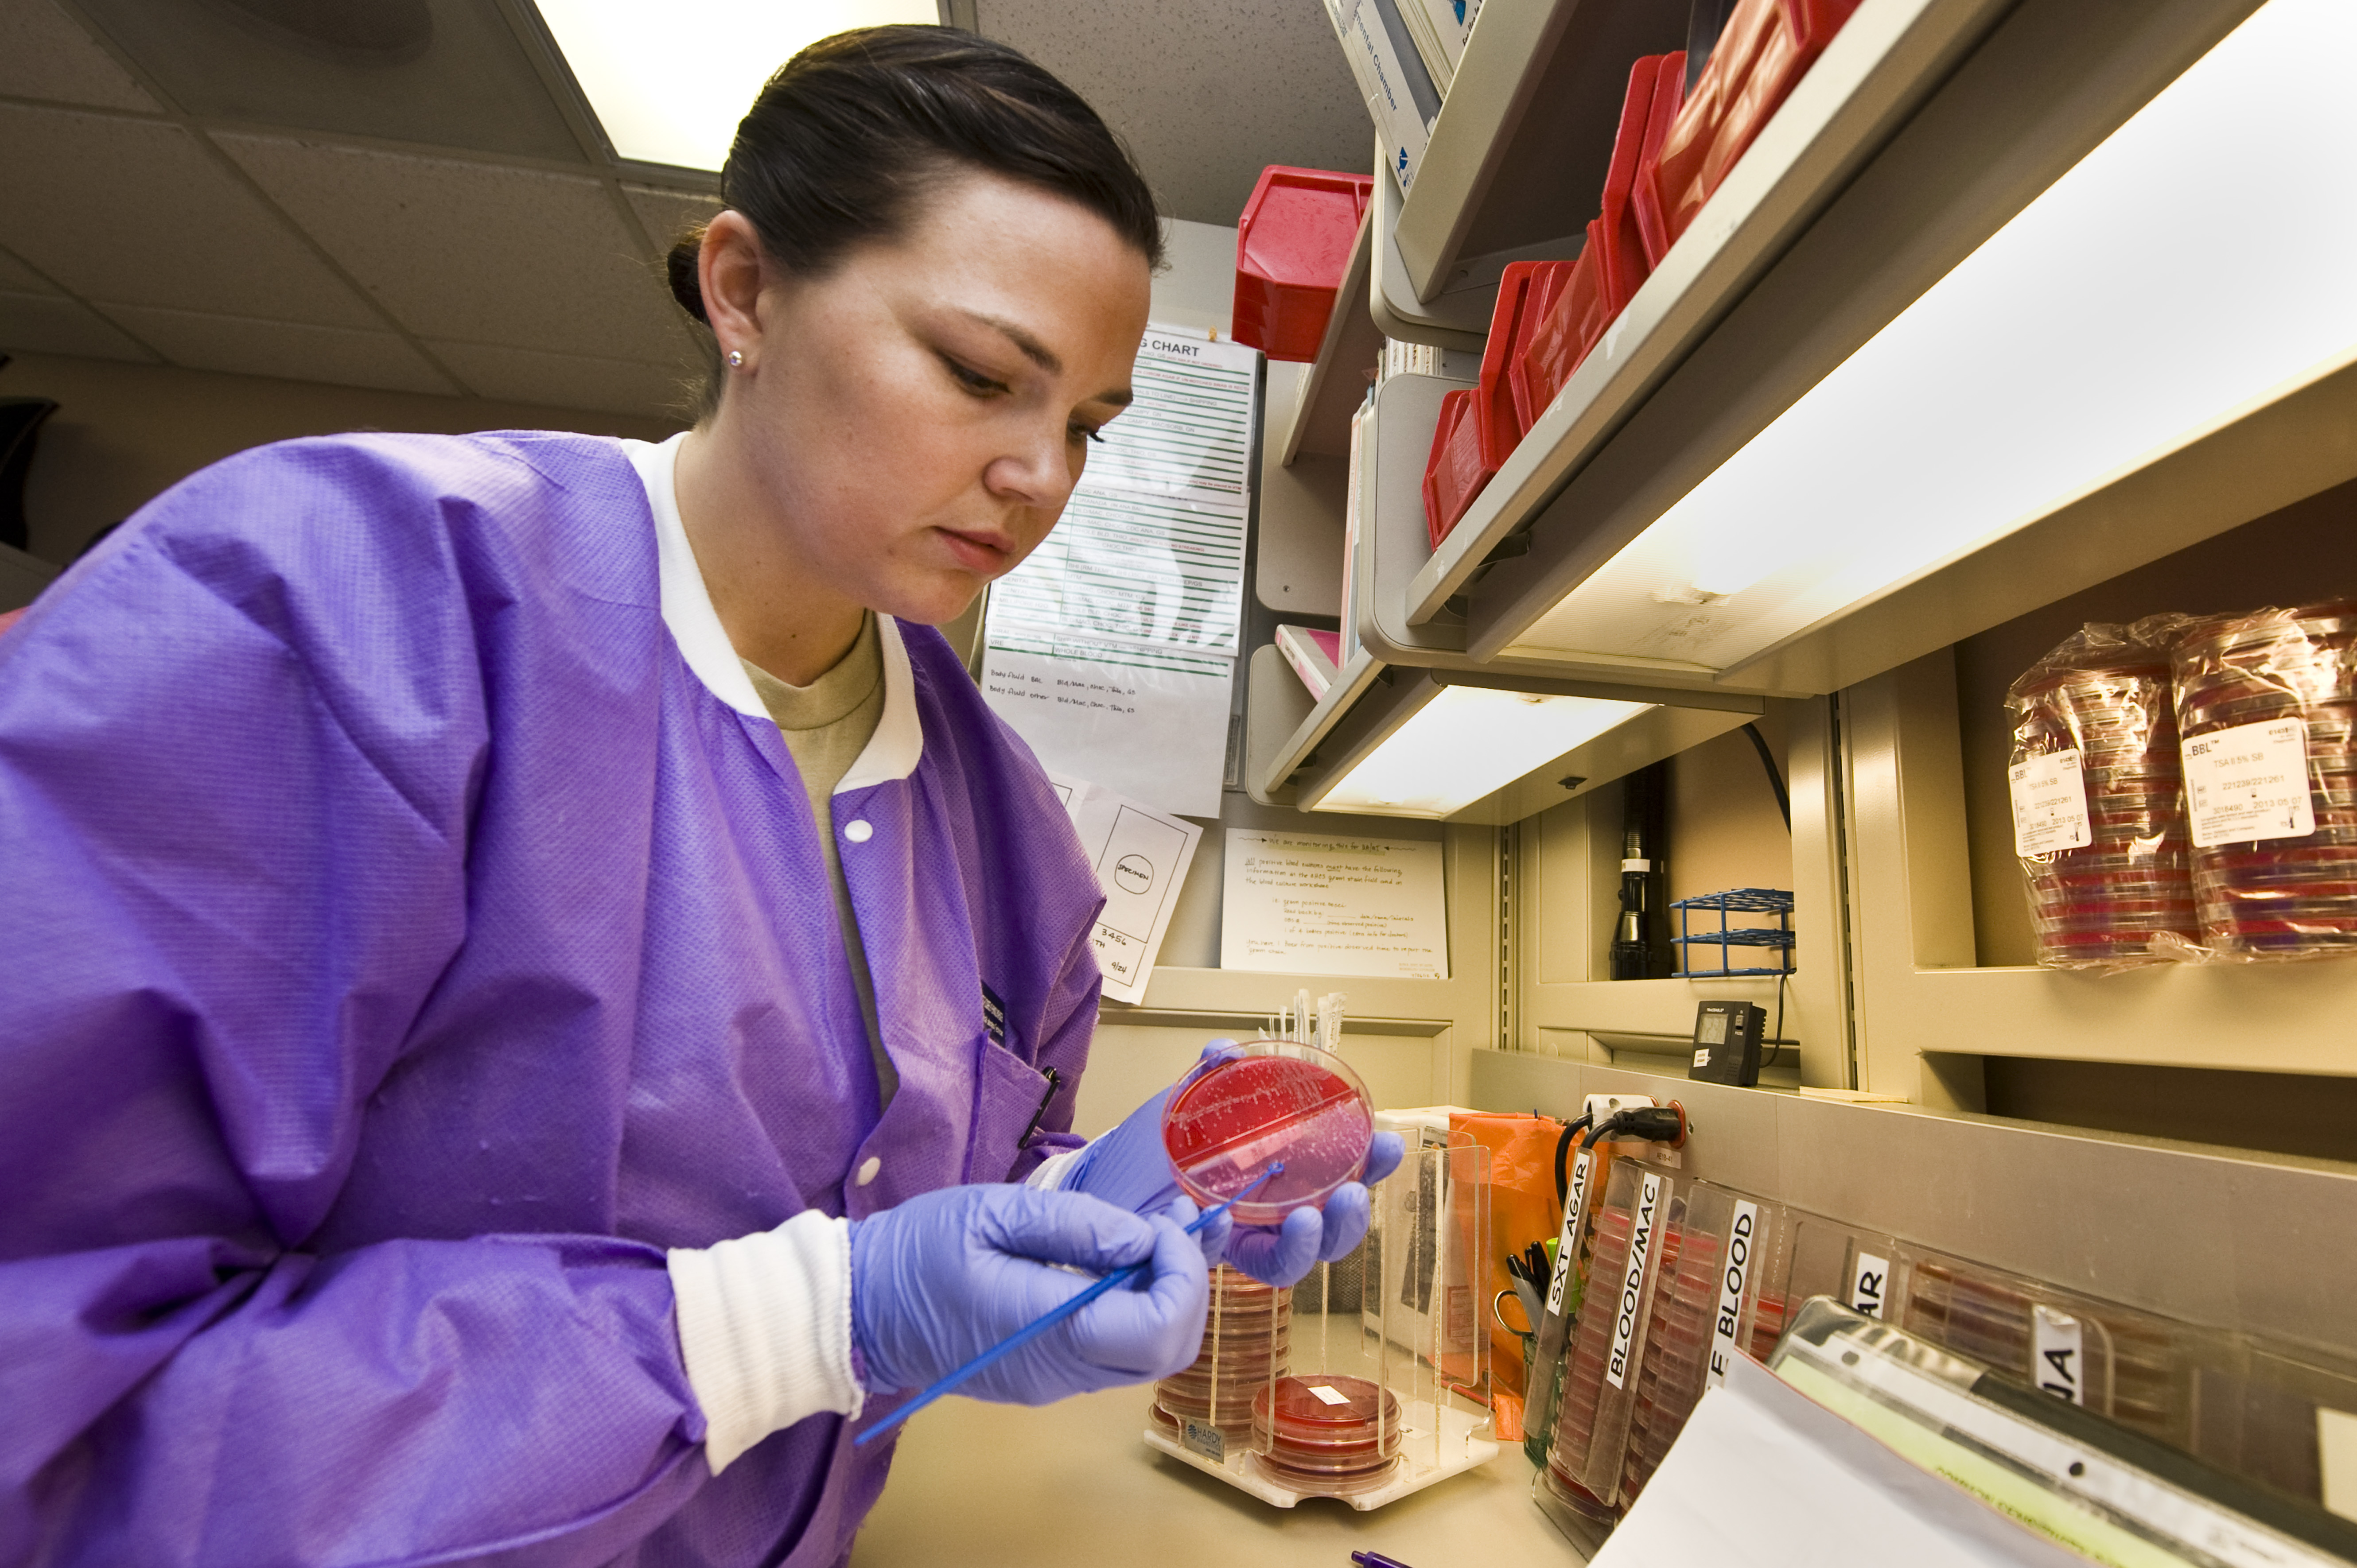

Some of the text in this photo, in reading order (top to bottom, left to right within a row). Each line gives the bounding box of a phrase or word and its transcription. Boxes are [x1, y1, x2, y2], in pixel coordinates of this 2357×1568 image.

[1373, 54, 1397, 112] Chamber
[1152, 340, 1200, 357] CHART
[1189, 398, 1217, 406] SHIPPING
[1073, 638, 1102, 648] WITHOUT
[1055, 647, 1078, 656] WHOLE
[1079, 649, 1102, 658] BLOOD
[991, 669, 1006, 678] Body
[989, 685, 1005, 695] Body
[2214, 758, 2230, 768] TSA
[2237, 755, 2250, 765] 5%
[2252, 752, 2264, 762] SB
[2252, 799, 2275, 809] 2013
[2277, 798, 2289, 806] 05
[2291, 796, 2302, 805] 07
[1117, 864, 1149, 880] SPECIMEN
[1102, 928, 1126, 946] 3456
[1552, 1163, 1587, 1306] SXT AGAR
[1610, 1184, 1656, 1378] BLOOD/MAC
[1718, 1213, 1752, 1339] BLOOD
[1197, 1427, 1221, 1445] HARDY
